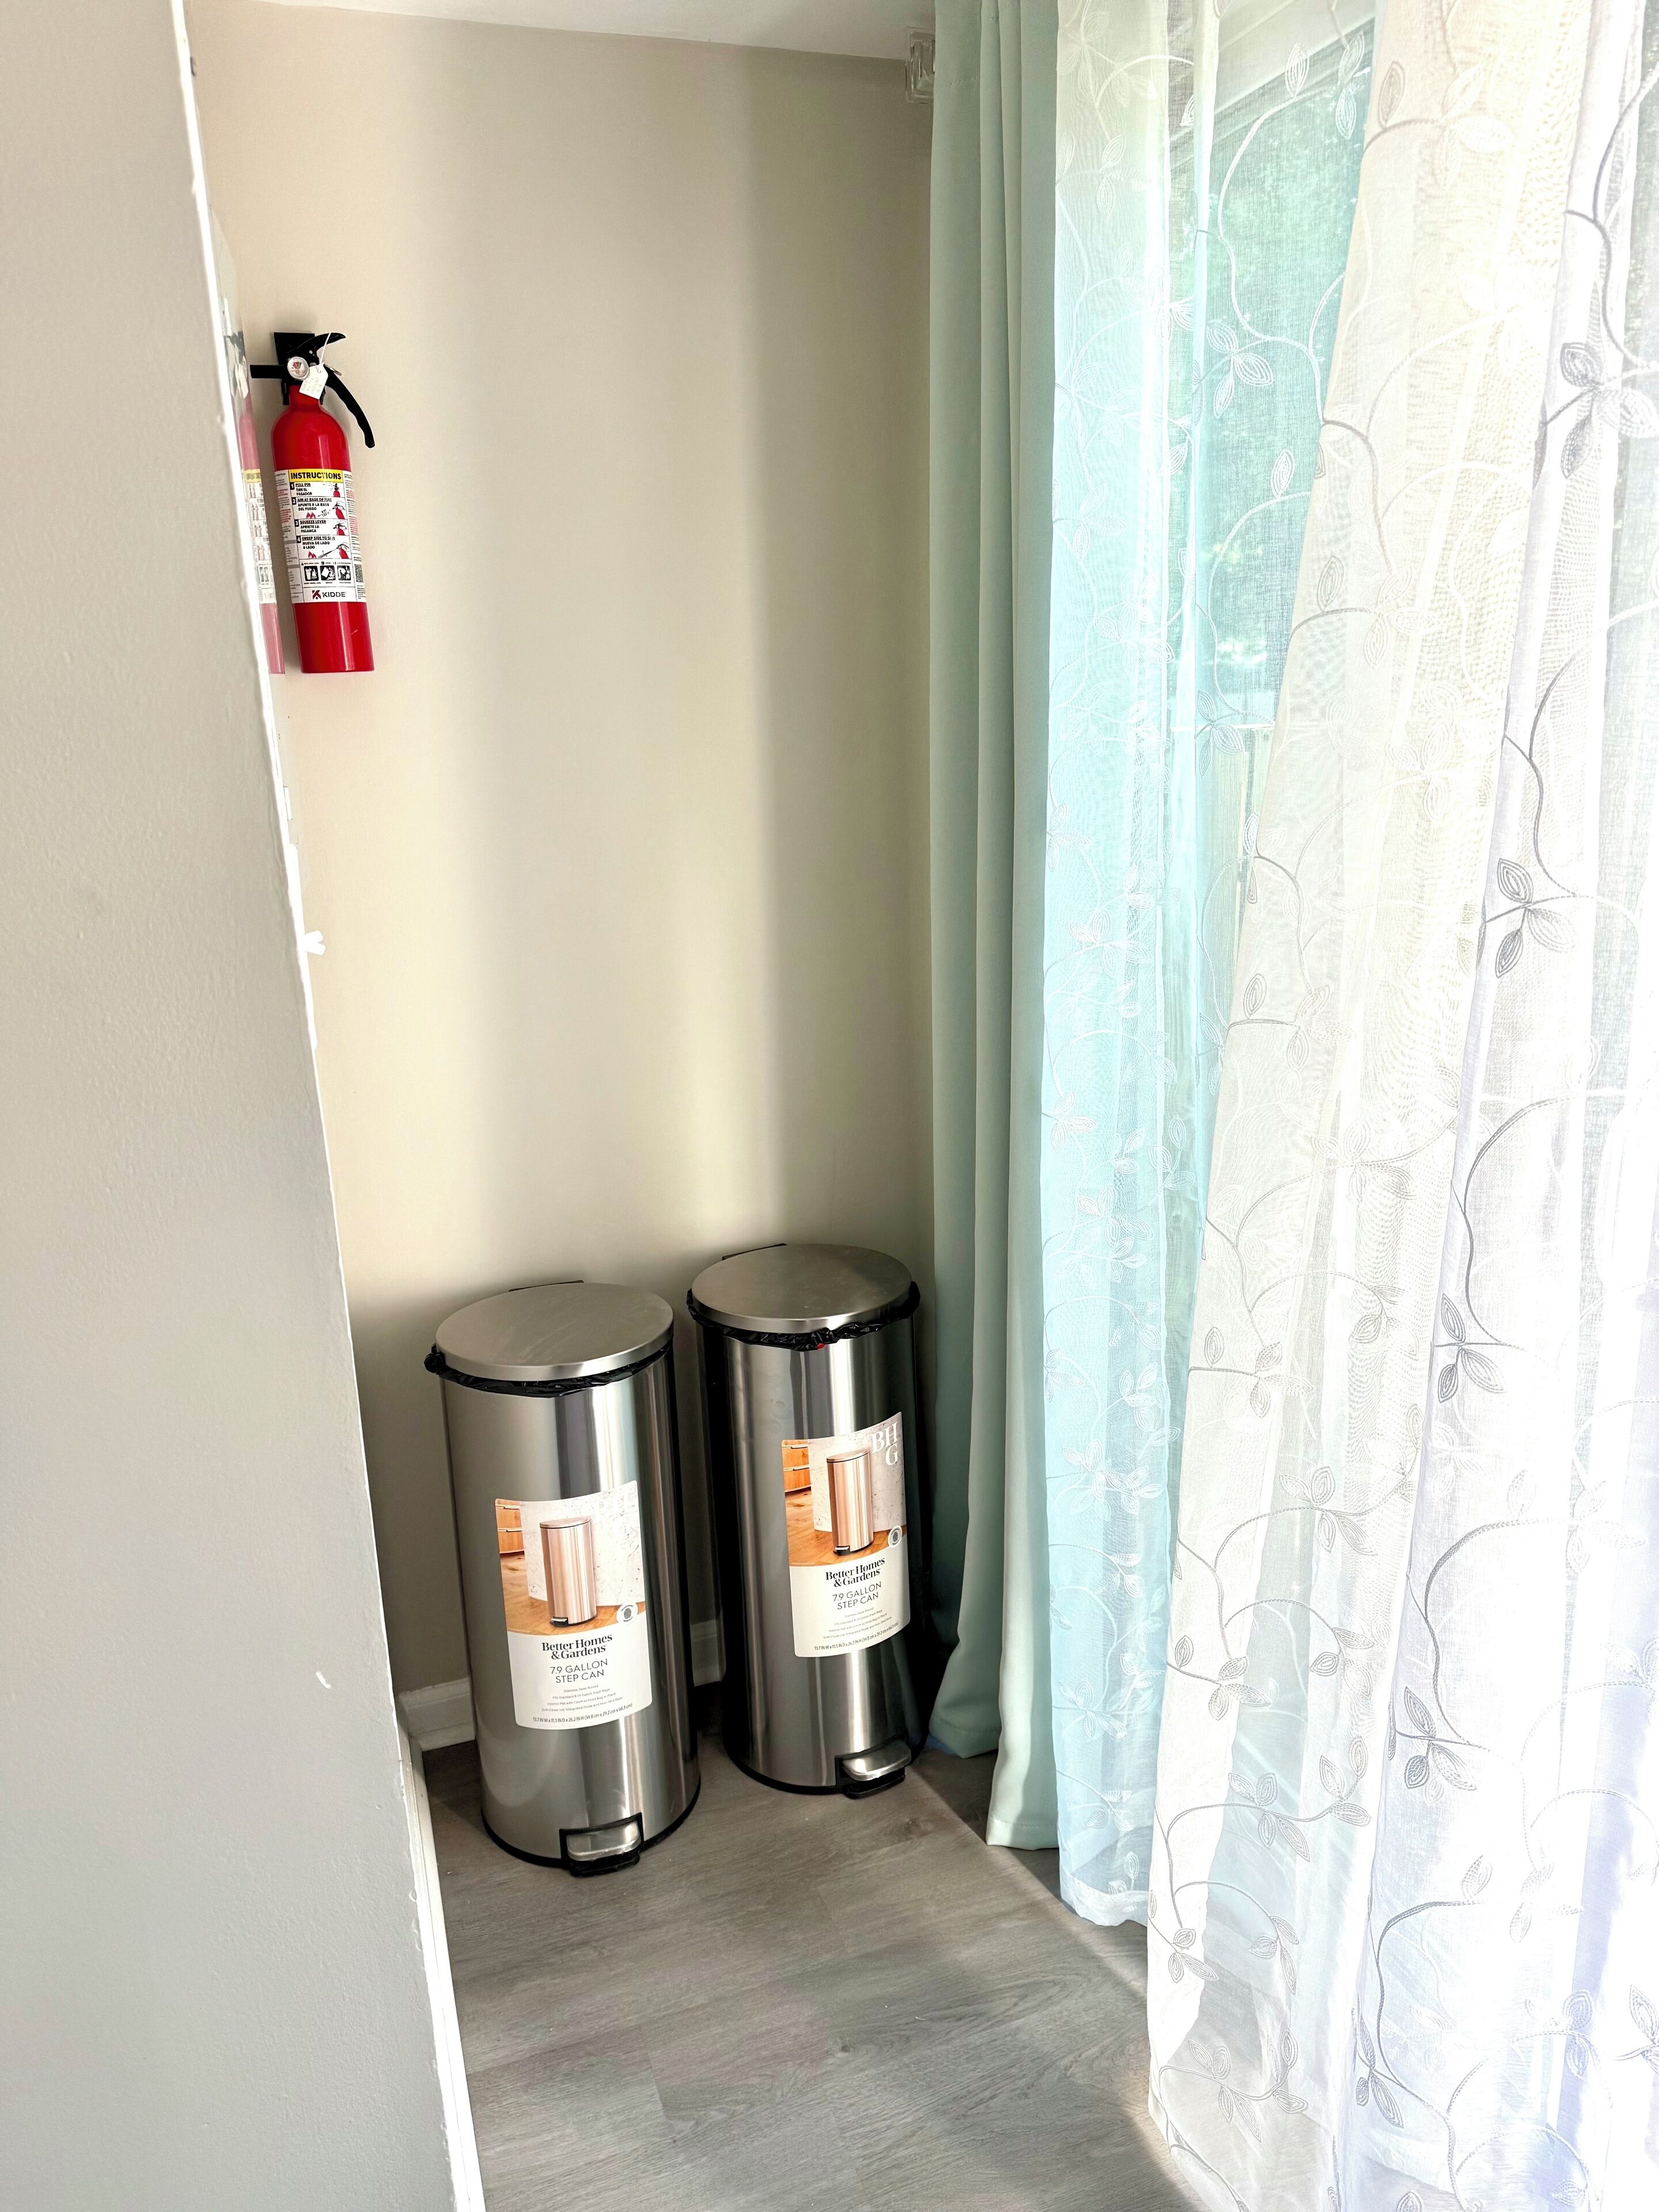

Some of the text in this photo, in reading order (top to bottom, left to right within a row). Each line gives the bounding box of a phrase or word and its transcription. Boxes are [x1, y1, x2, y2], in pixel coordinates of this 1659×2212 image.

[870, 1422, 898, 1453] BH
[886, 1442, 898, 1465] G
[826, 1558, 885, 1580] Better Homes
[834, 1569, 880, 1588] & Gardens
[832, 1581, 881, 1601] 7.9 GALLON
[838, 1591, 878, 1610] STEP CAN
[541, 1635, 613, 1651] Better Homes
[551, 1645, 606, 1660] & Gardens
[550, 1658, 608, 1675] 7.9 GALLON
[556, 1669, 604, 1683] STEP CAN
